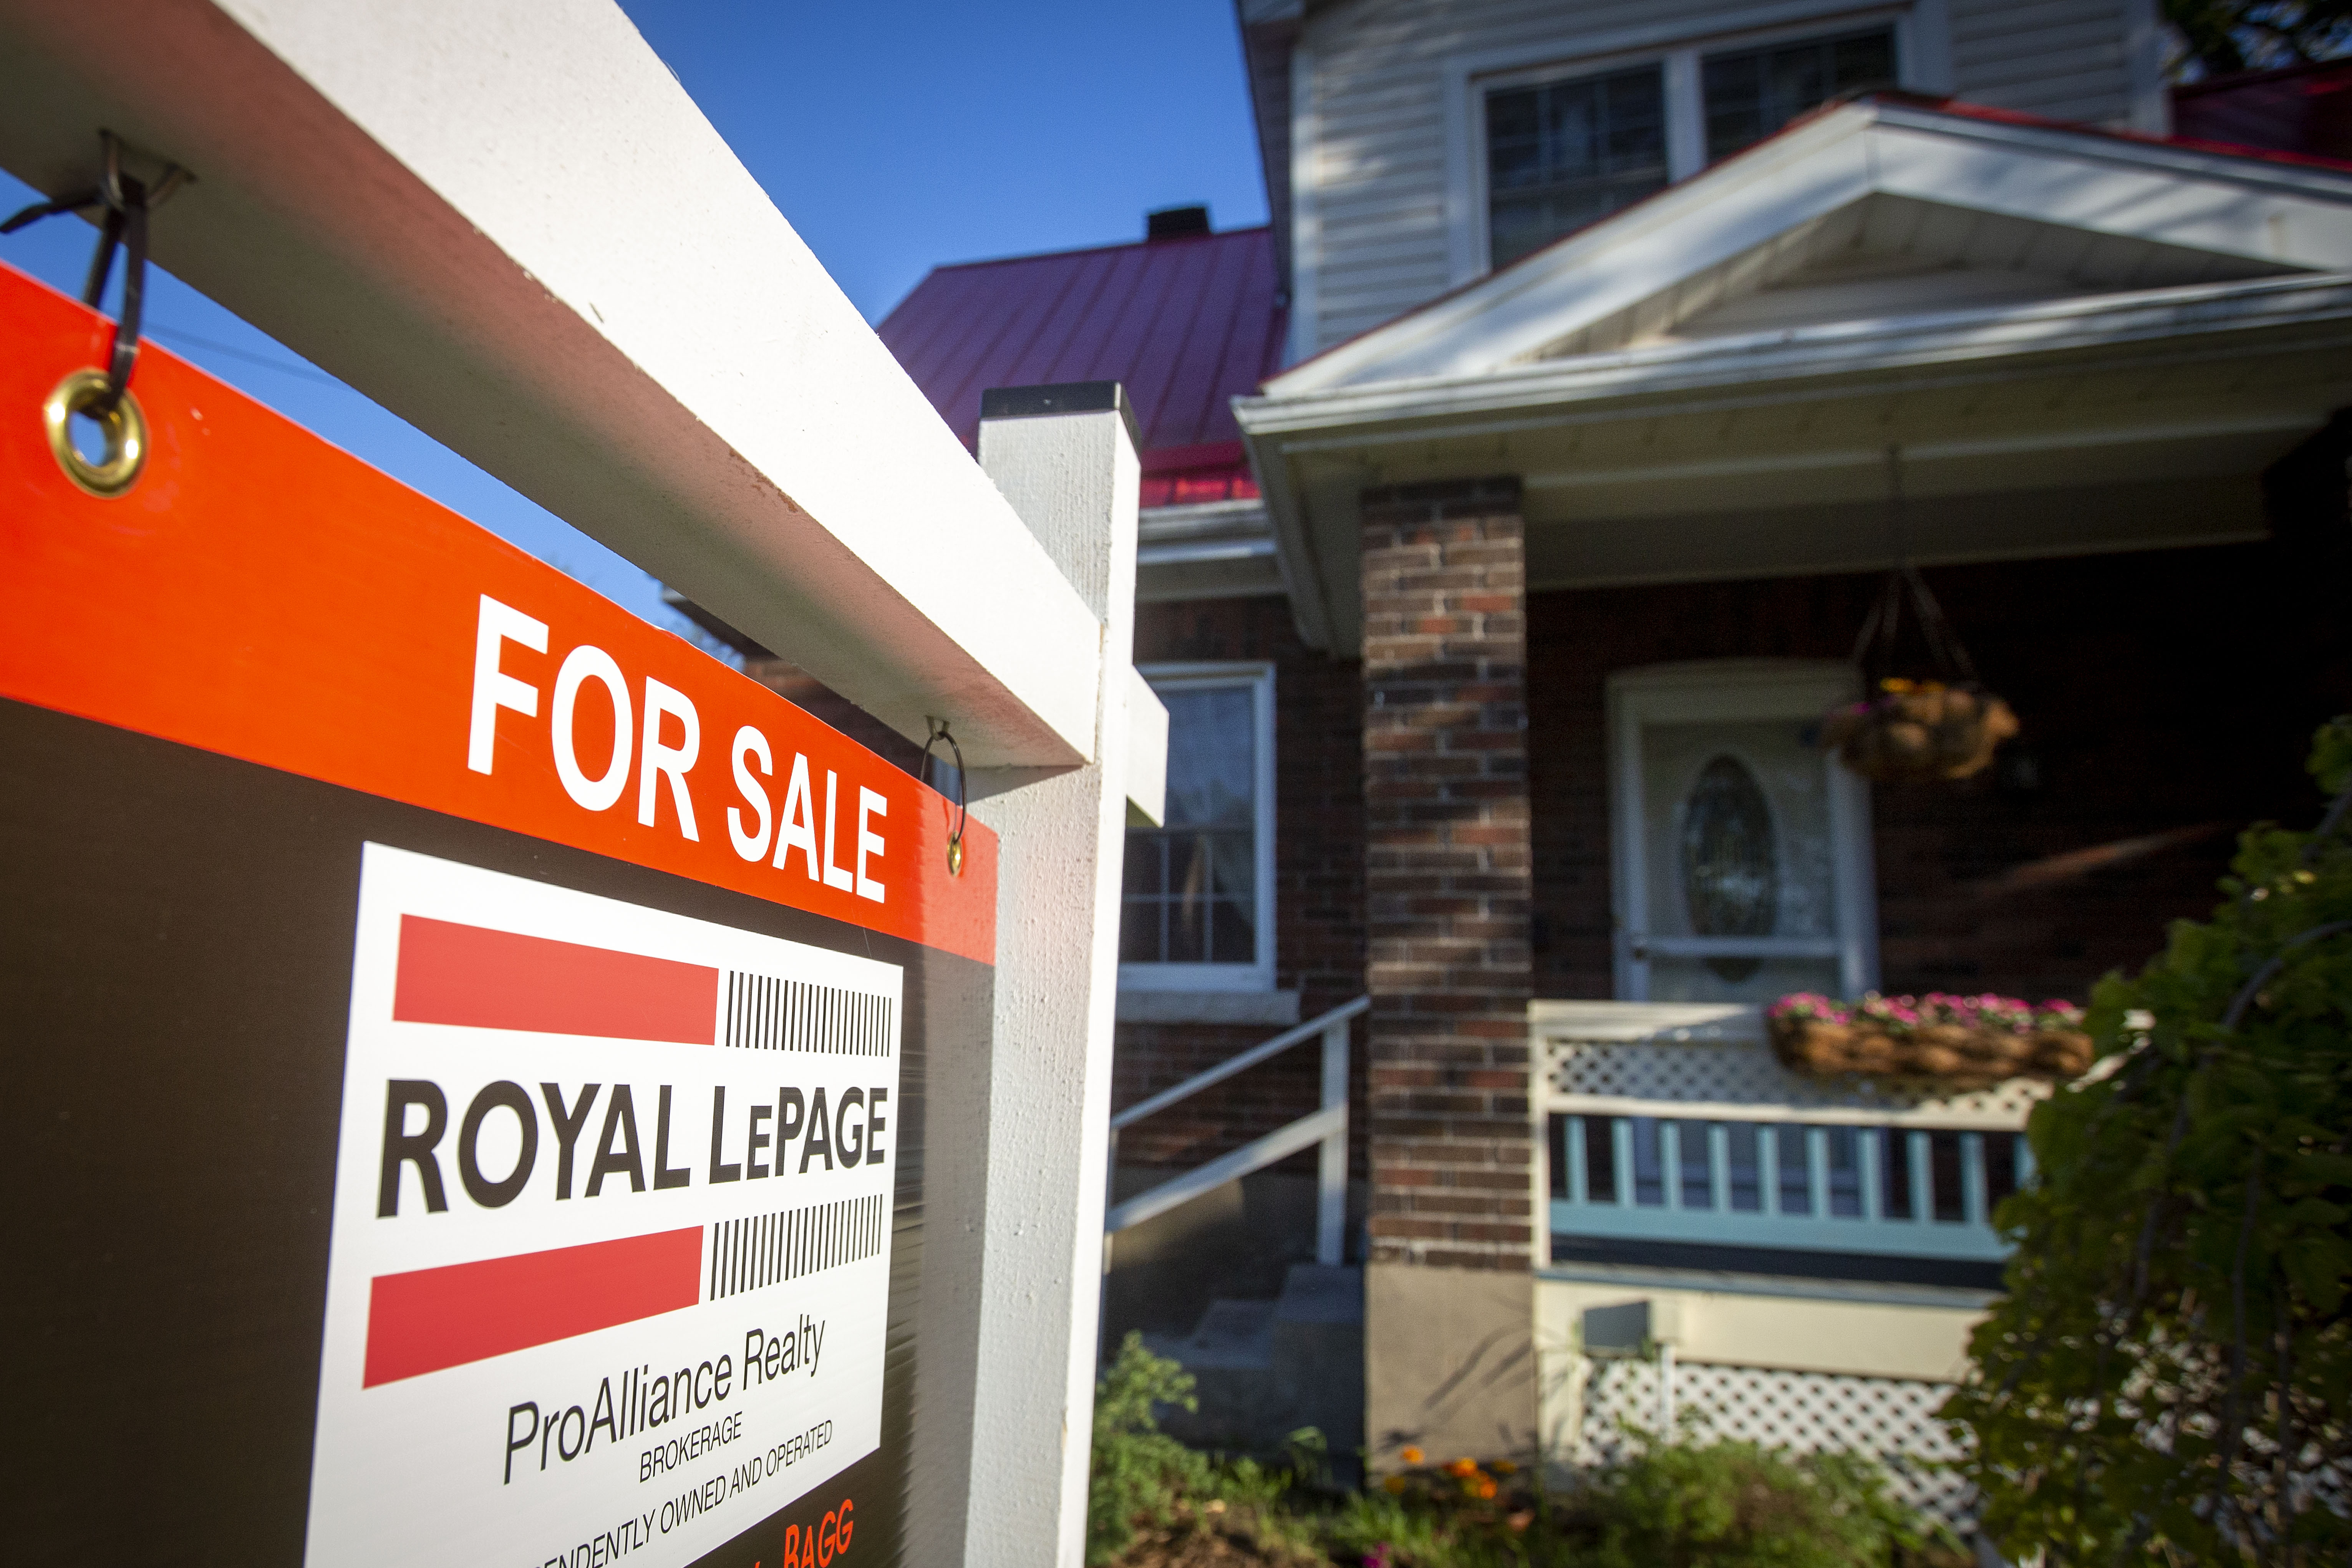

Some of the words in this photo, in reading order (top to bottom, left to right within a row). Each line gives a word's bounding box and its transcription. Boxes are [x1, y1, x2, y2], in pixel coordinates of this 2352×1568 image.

[467, 594, 700, 842] FOR
[727, 725, 888, 903] SALE
[376, 1079, 691, 1219] ROYAL
[504, 1354, 732, 1485] ProAlliance
[743, 1314, 825, 1391] Realty
[640, 1411, 743, 1483] BROKERAGE
[660, 1475, 726, 1534] OWNED
[729, 1457, 762, 1498] AND
[766, 1420, 832, 1477] OPERATED
[784, 1499, 854, 1568] BAGG
